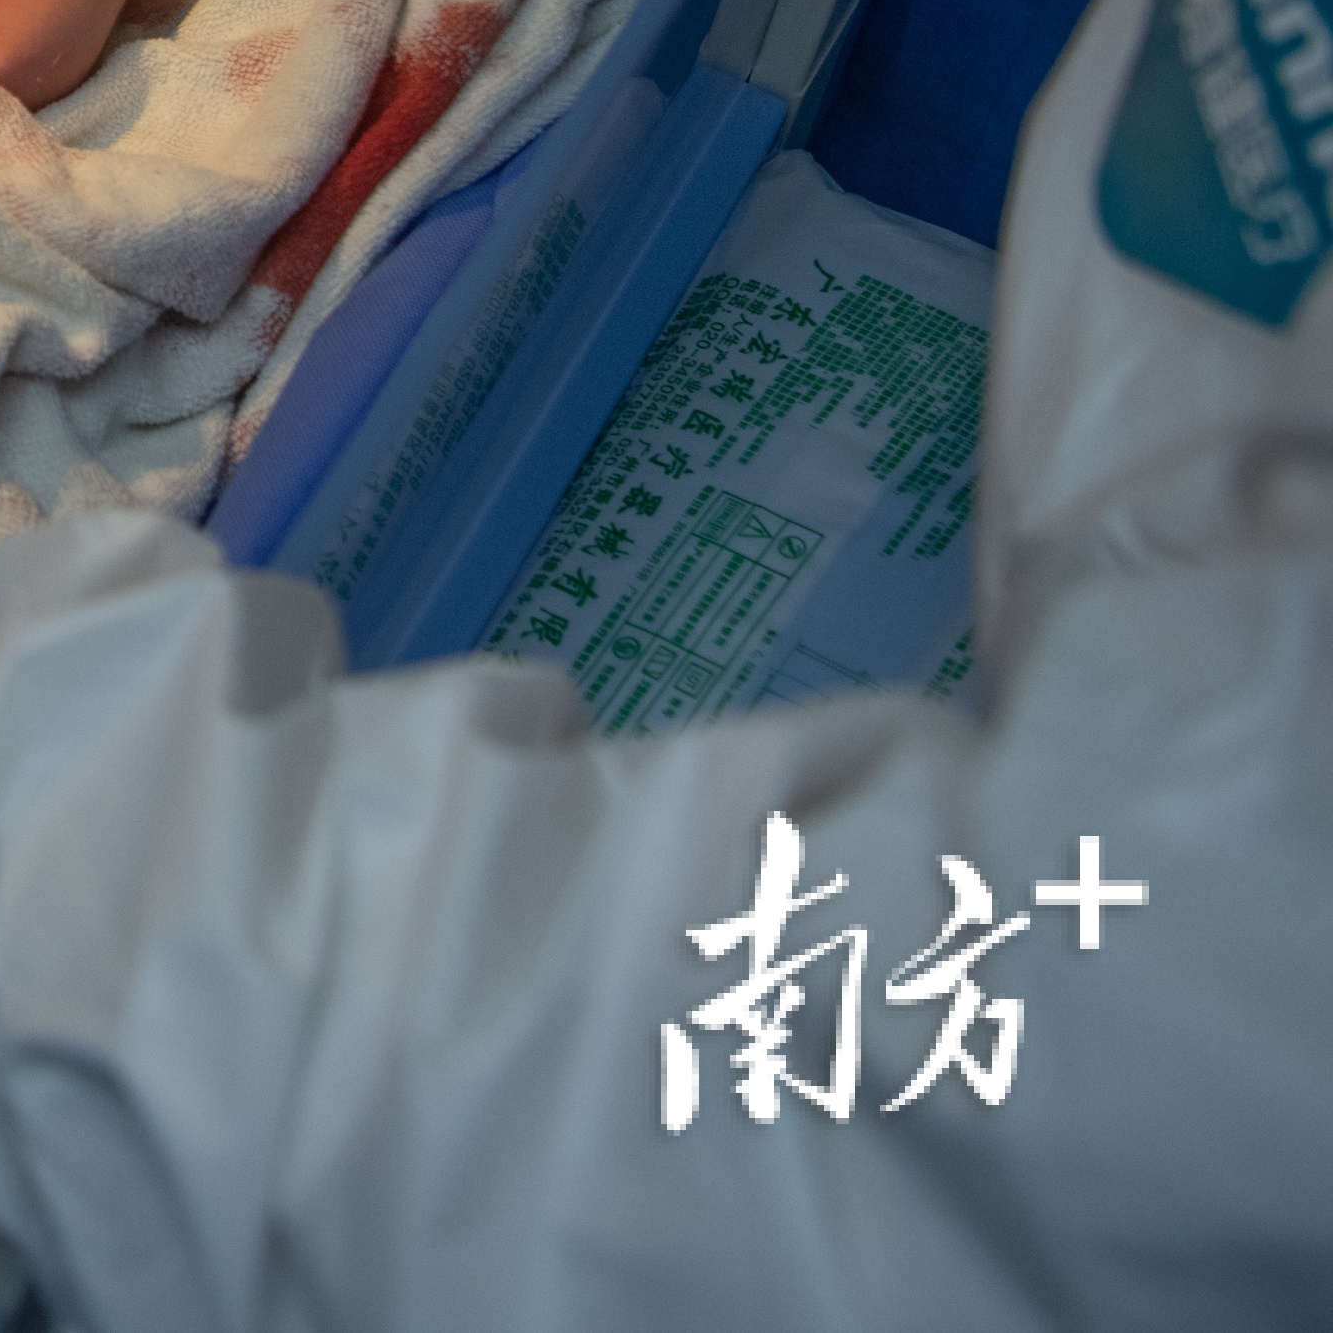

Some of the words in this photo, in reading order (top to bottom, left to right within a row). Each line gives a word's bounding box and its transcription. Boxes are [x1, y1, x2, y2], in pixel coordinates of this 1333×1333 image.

[504, 258, 846, 668] 广东宏瑞医疗器械有限
